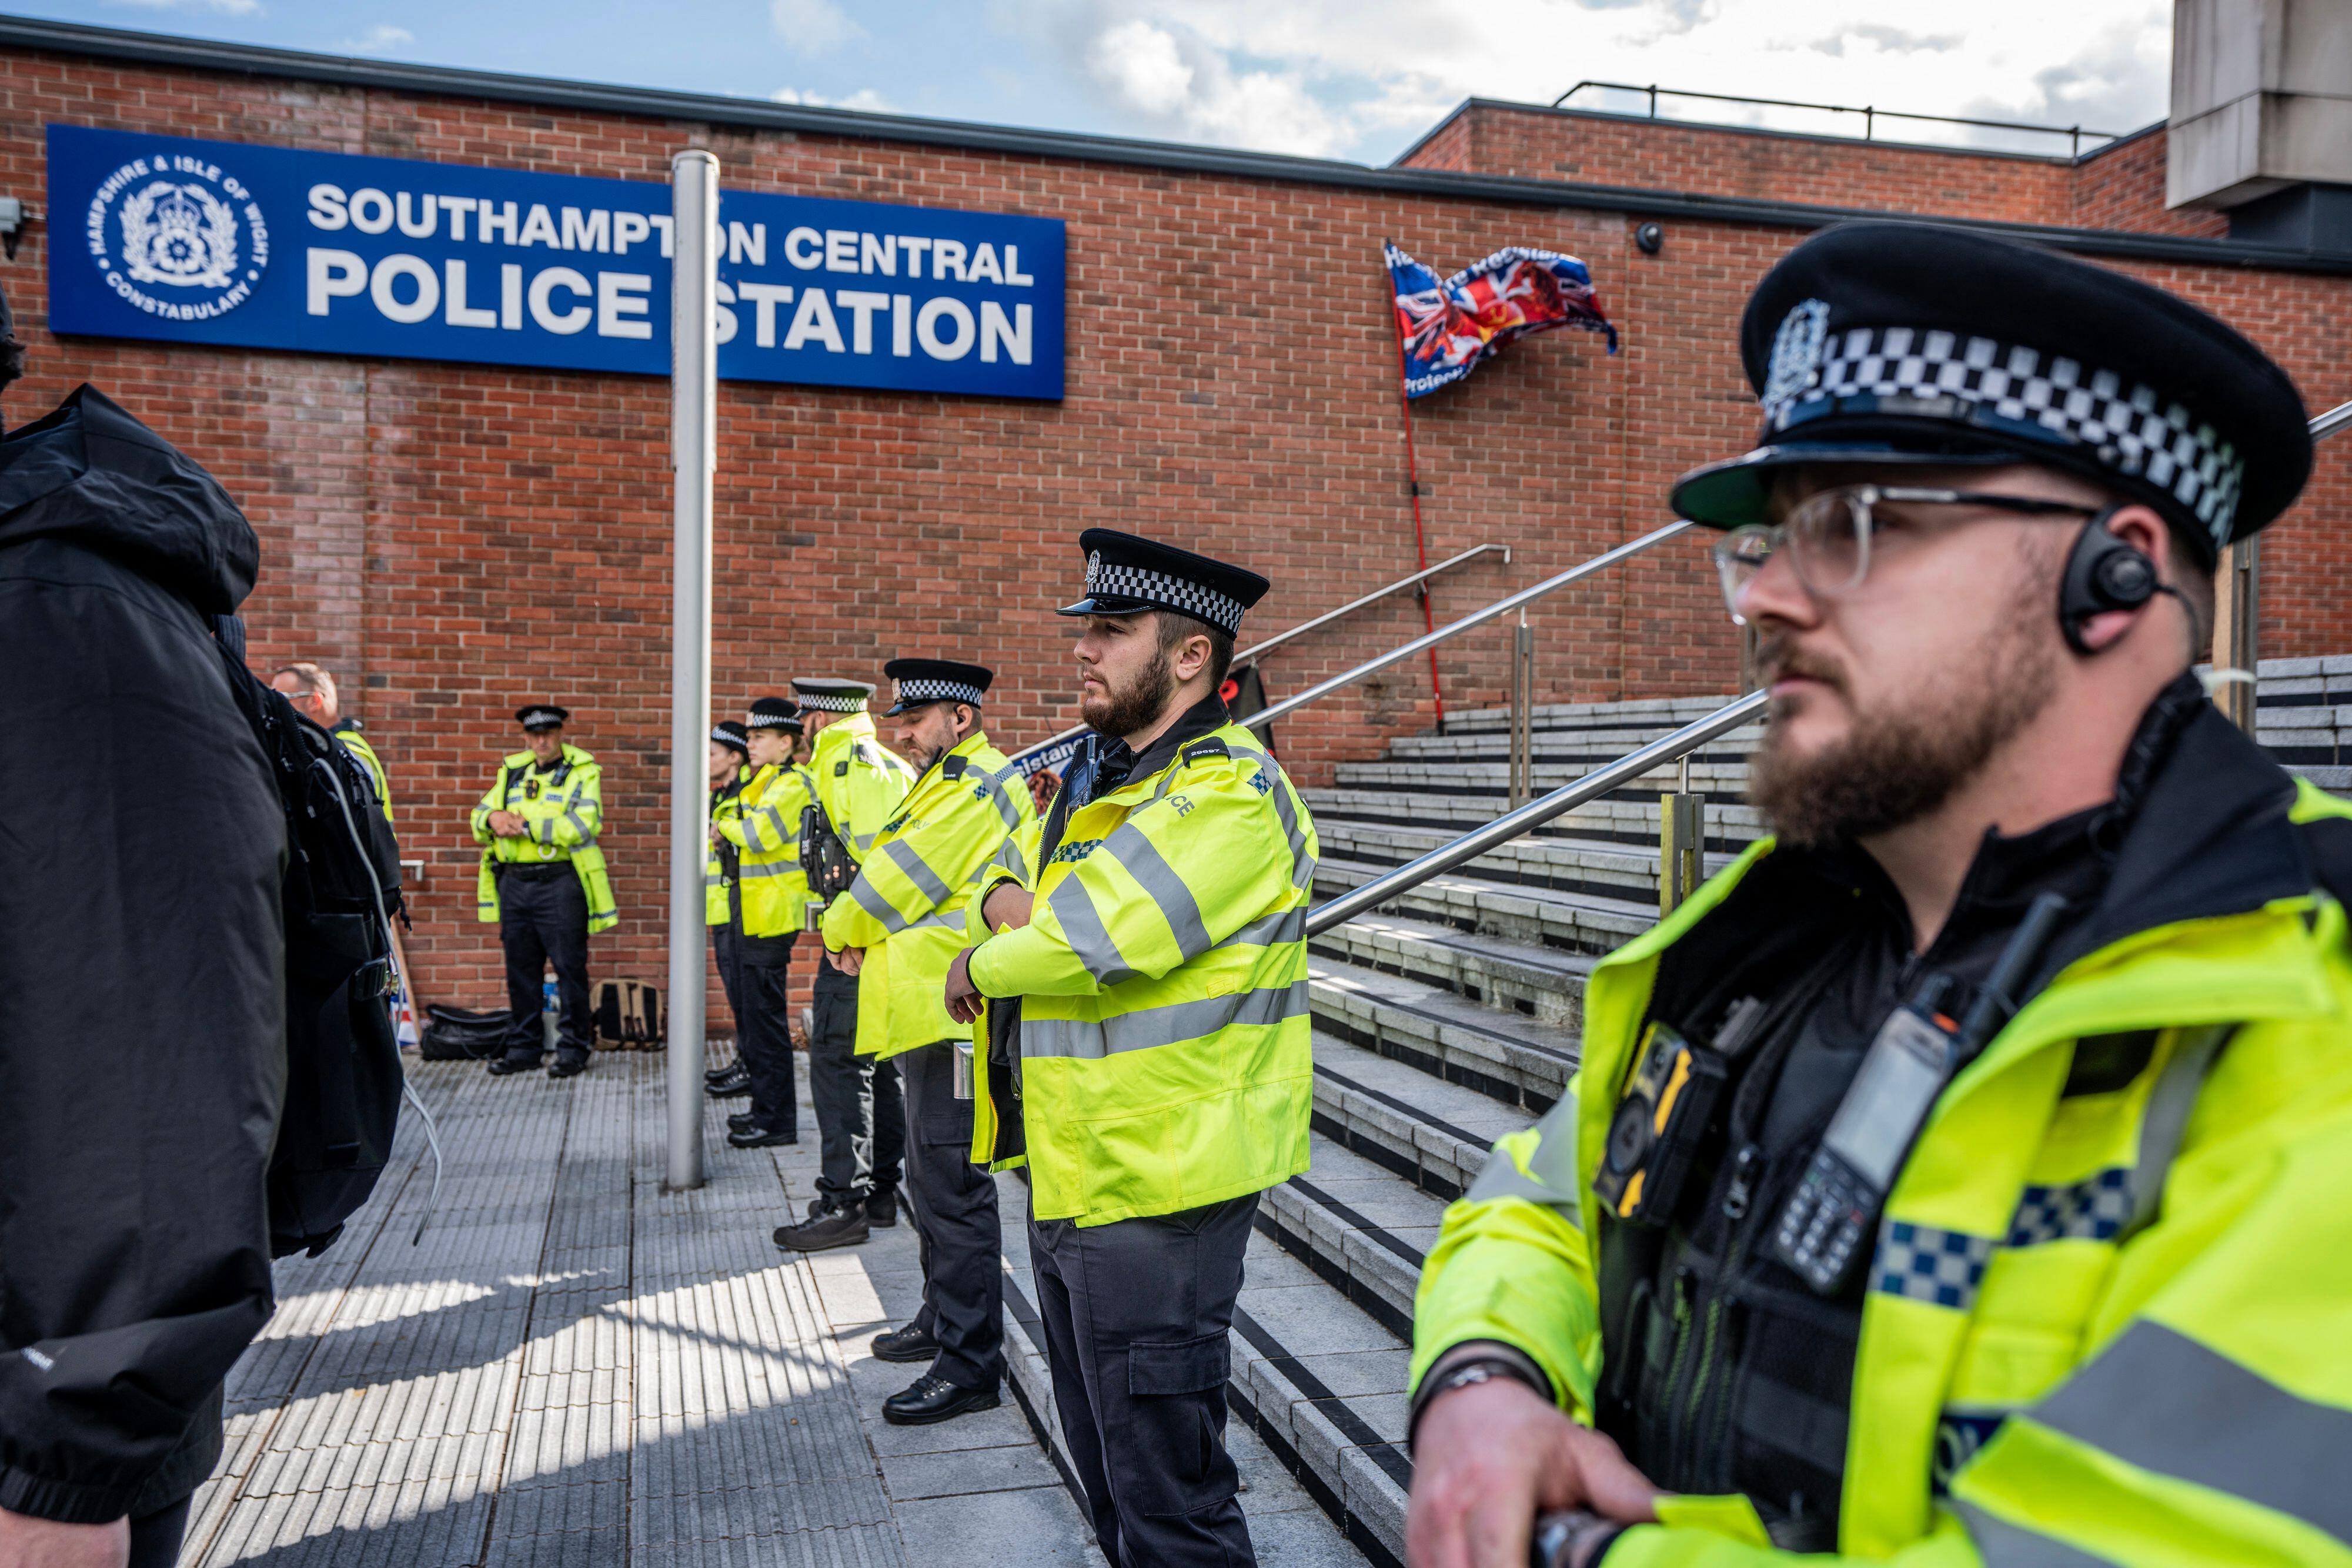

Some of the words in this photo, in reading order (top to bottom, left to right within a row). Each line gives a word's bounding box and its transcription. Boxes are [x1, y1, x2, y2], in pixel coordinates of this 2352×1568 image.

[87, 159, 149, 255] HAMPSHIRE
[153, 155, 169, 171] &
[174, 155, 222, 183] ISLE
[223, 177, 250, 200] OF
[244, 202, 269, 268] WIGHT
[308, 184, 766, 265] SOUTHAMPTN
[784, 227, 1034, 286] CENTRAL
[106, 271, 251, 320] CONSTABULARY
[308, 248, 652, 339] POLICE
